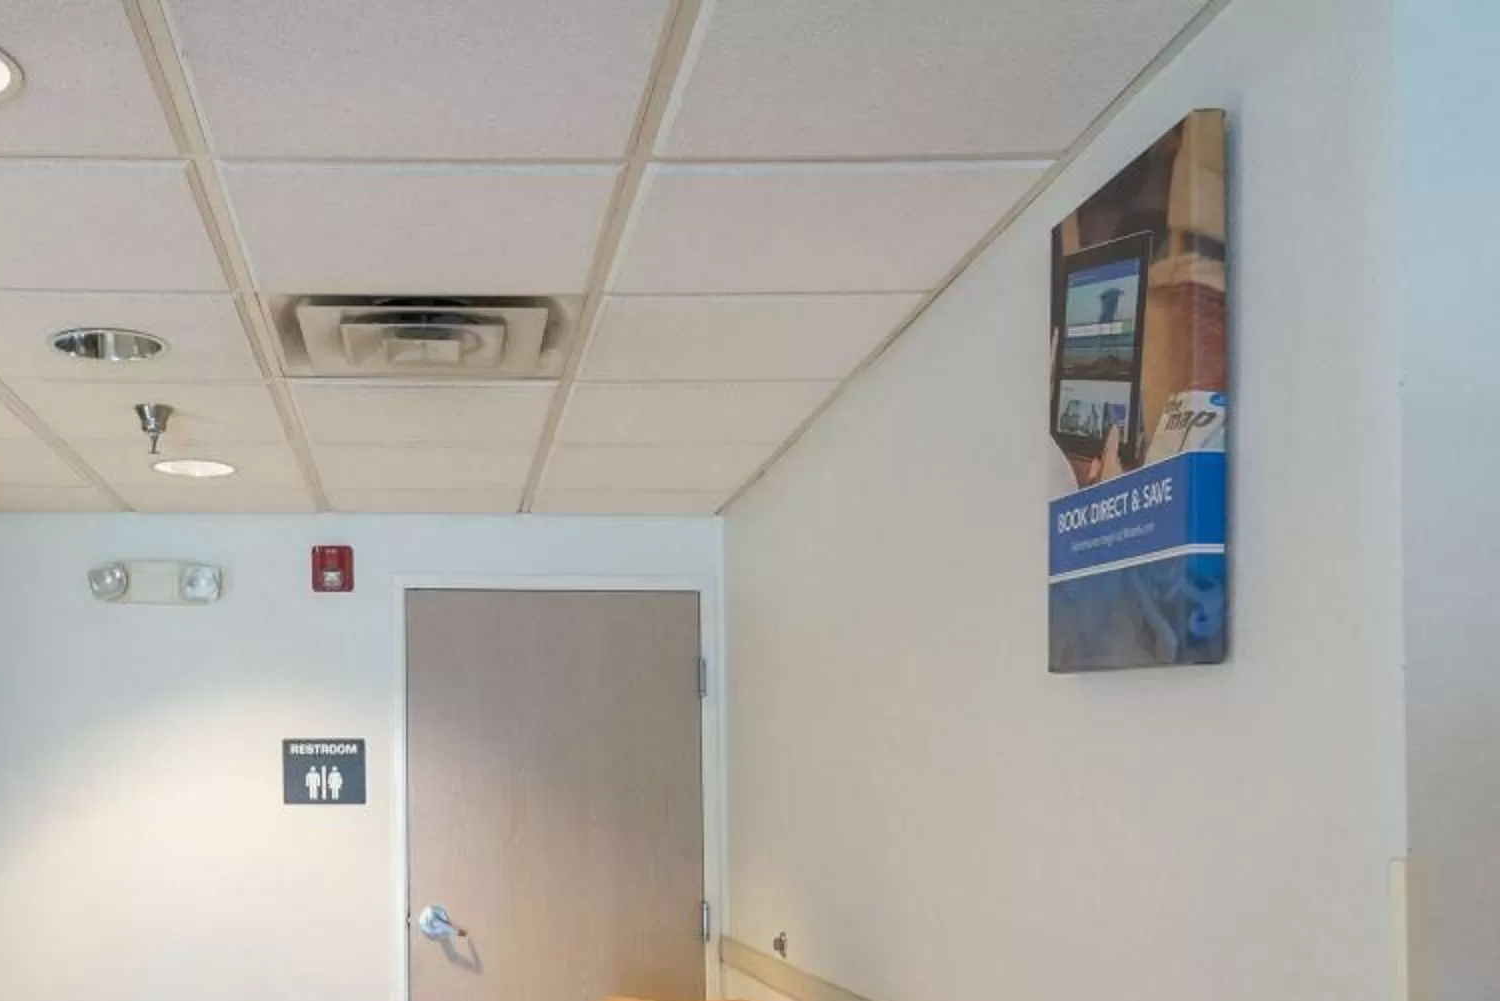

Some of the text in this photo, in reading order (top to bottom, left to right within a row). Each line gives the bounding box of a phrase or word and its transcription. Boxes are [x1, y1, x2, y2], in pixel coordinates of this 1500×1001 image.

[1057, 477, 1173, 533] BOOK DIRECT & SAVE
[289, 743, 358, 756] RESTROOM
